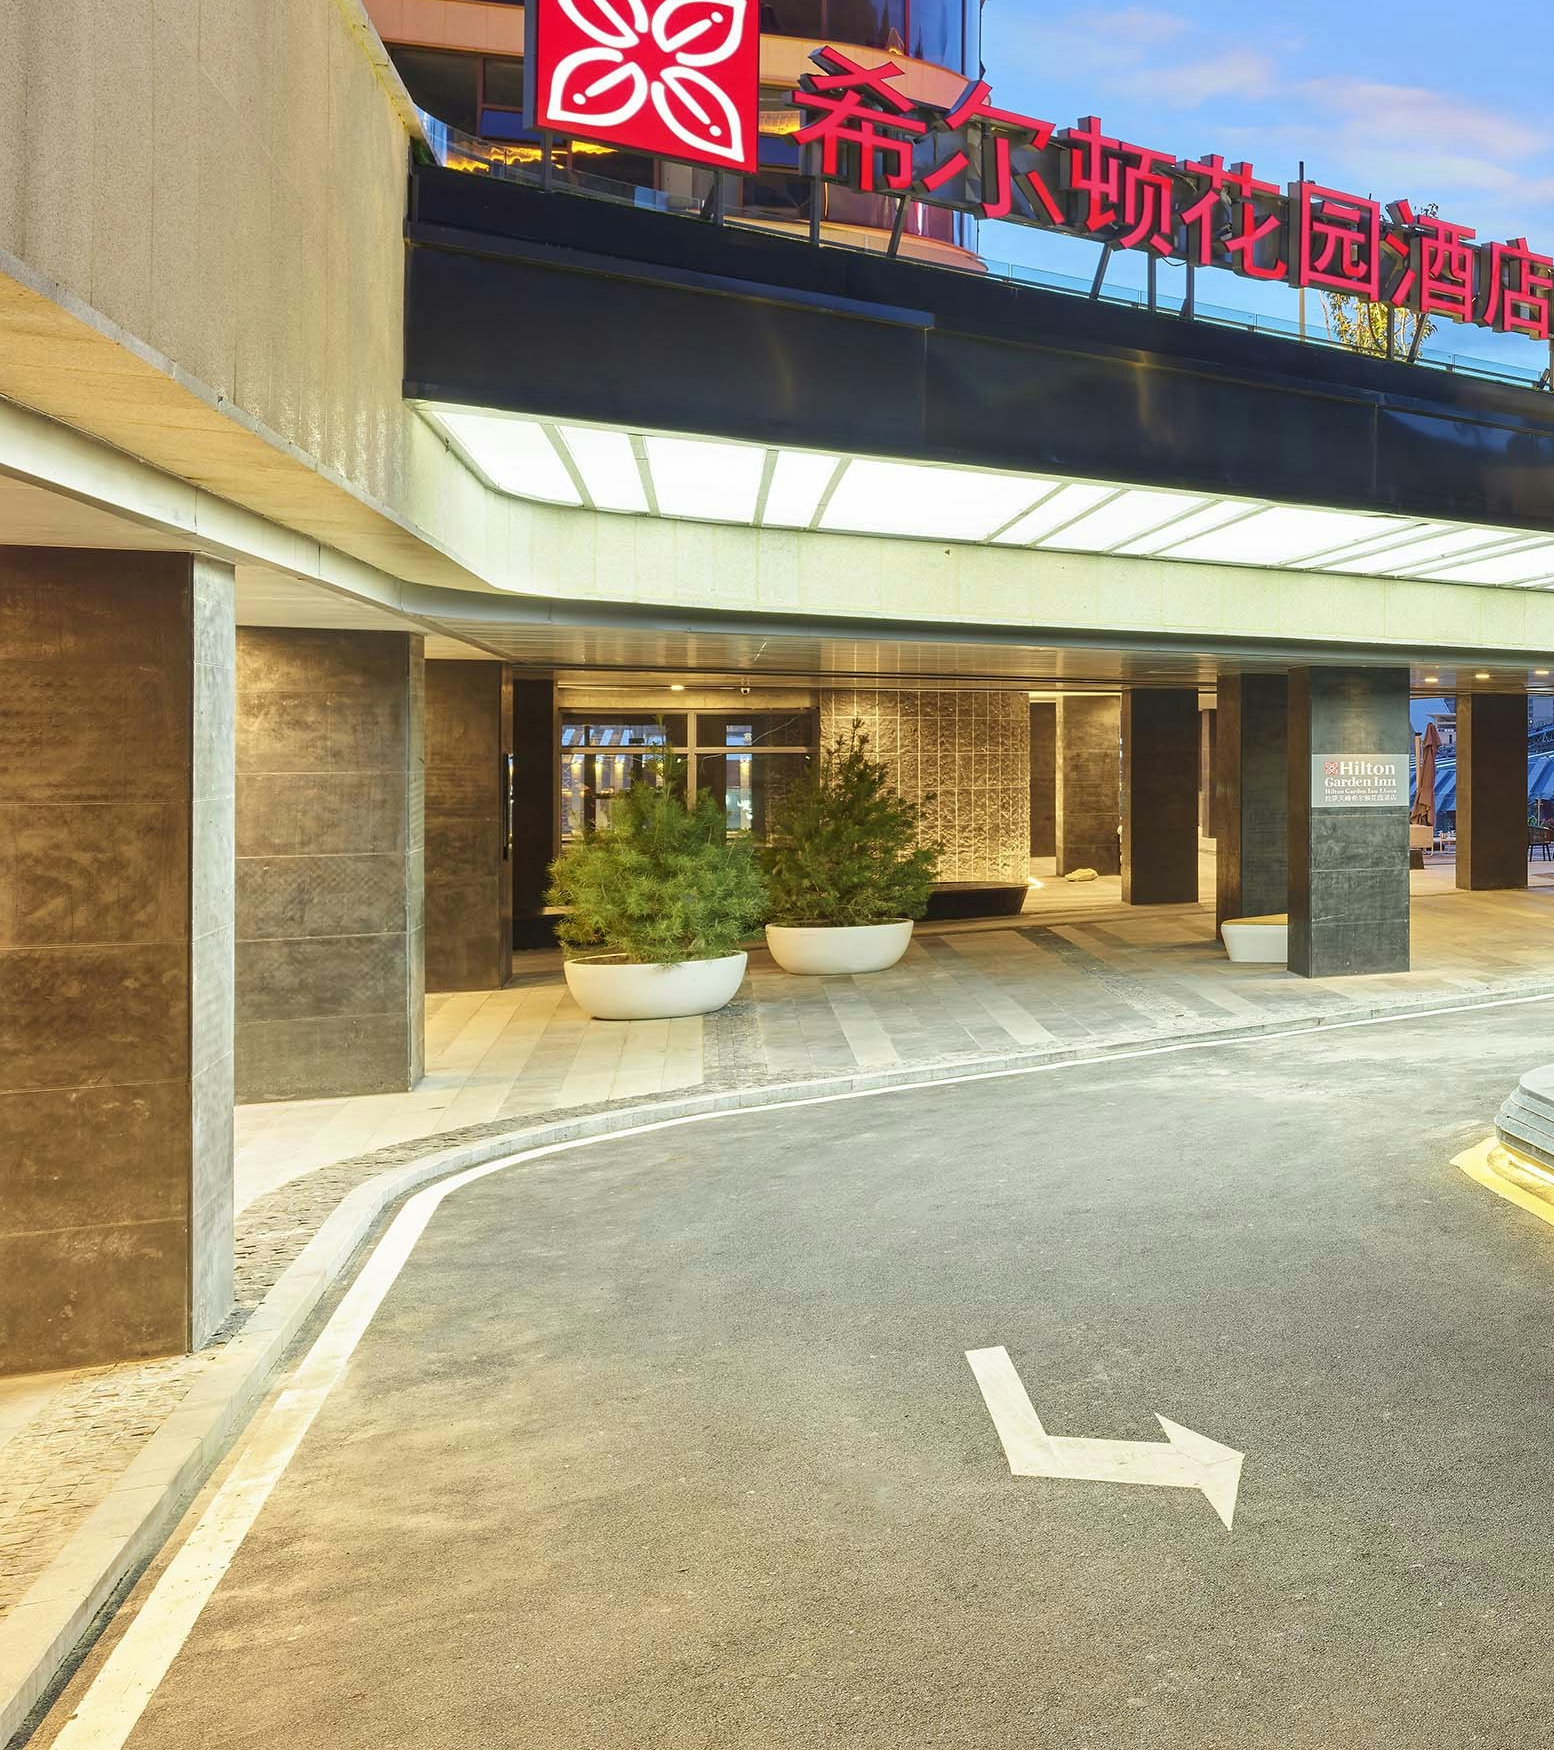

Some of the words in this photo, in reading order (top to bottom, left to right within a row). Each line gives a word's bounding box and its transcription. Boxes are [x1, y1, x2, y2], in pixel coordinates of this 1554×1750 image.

[792, 45, 1554, 340] 希尔顿花园酒店
[1340, 761, 1395, 776] Hilton
[1325, 777, 1370, 787] Garden
[1374, 777, 1396, 787] Inn
